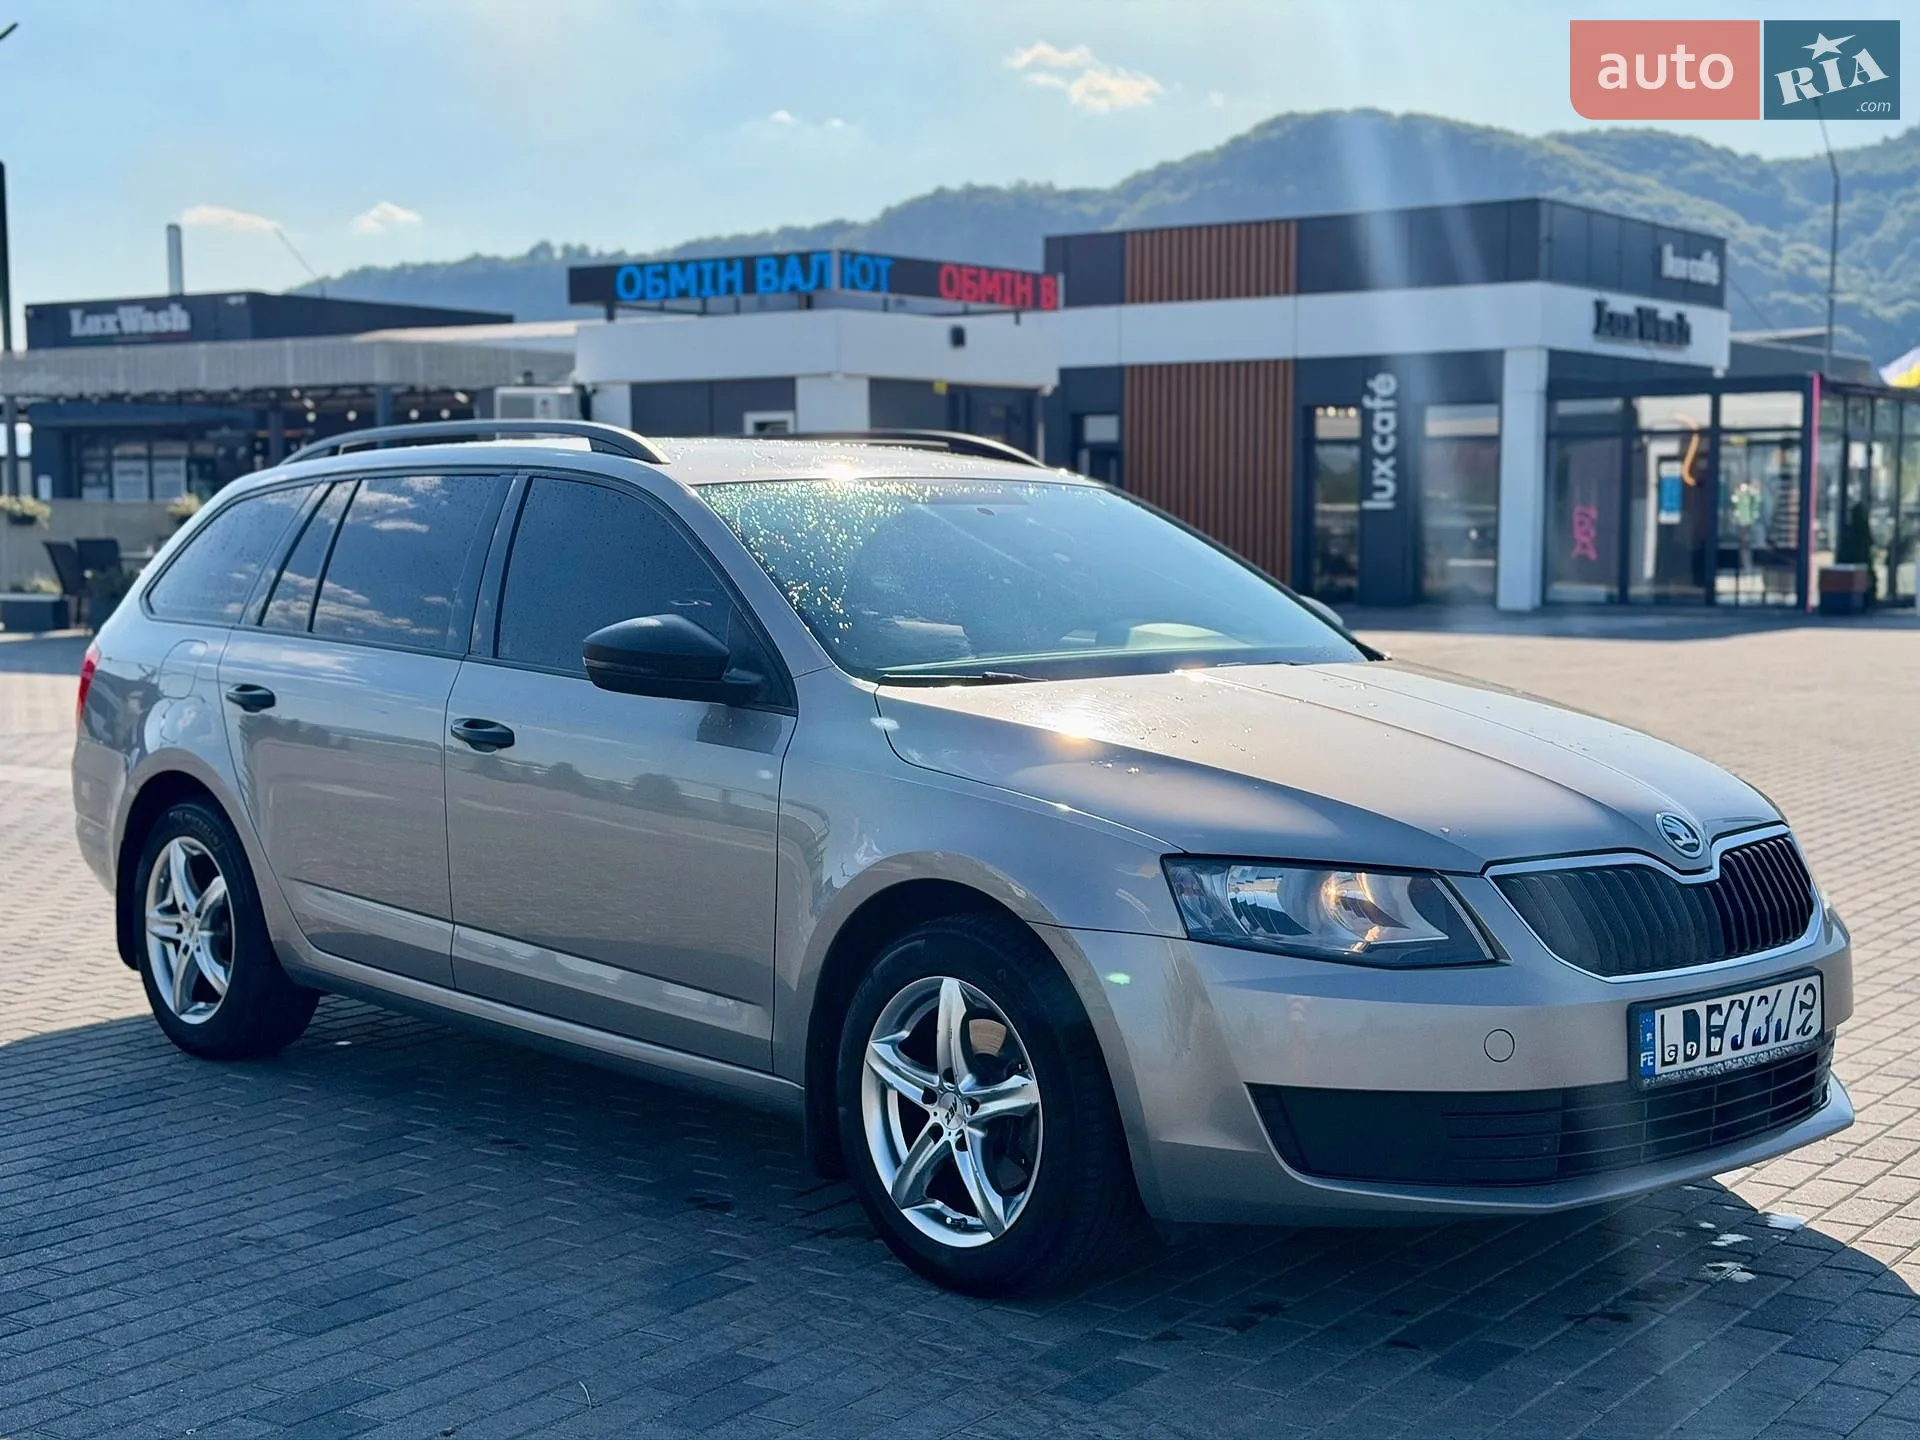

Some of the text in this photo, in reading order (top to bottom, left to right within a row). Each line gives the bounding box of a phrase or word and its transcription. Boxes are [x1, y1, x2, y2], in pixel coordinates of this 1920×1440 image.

[615, 258, 744, 301] ОБМІН
[938, 262, 1033, 309] ОБМІН
[1361, 373, 1397, 510] lux café
